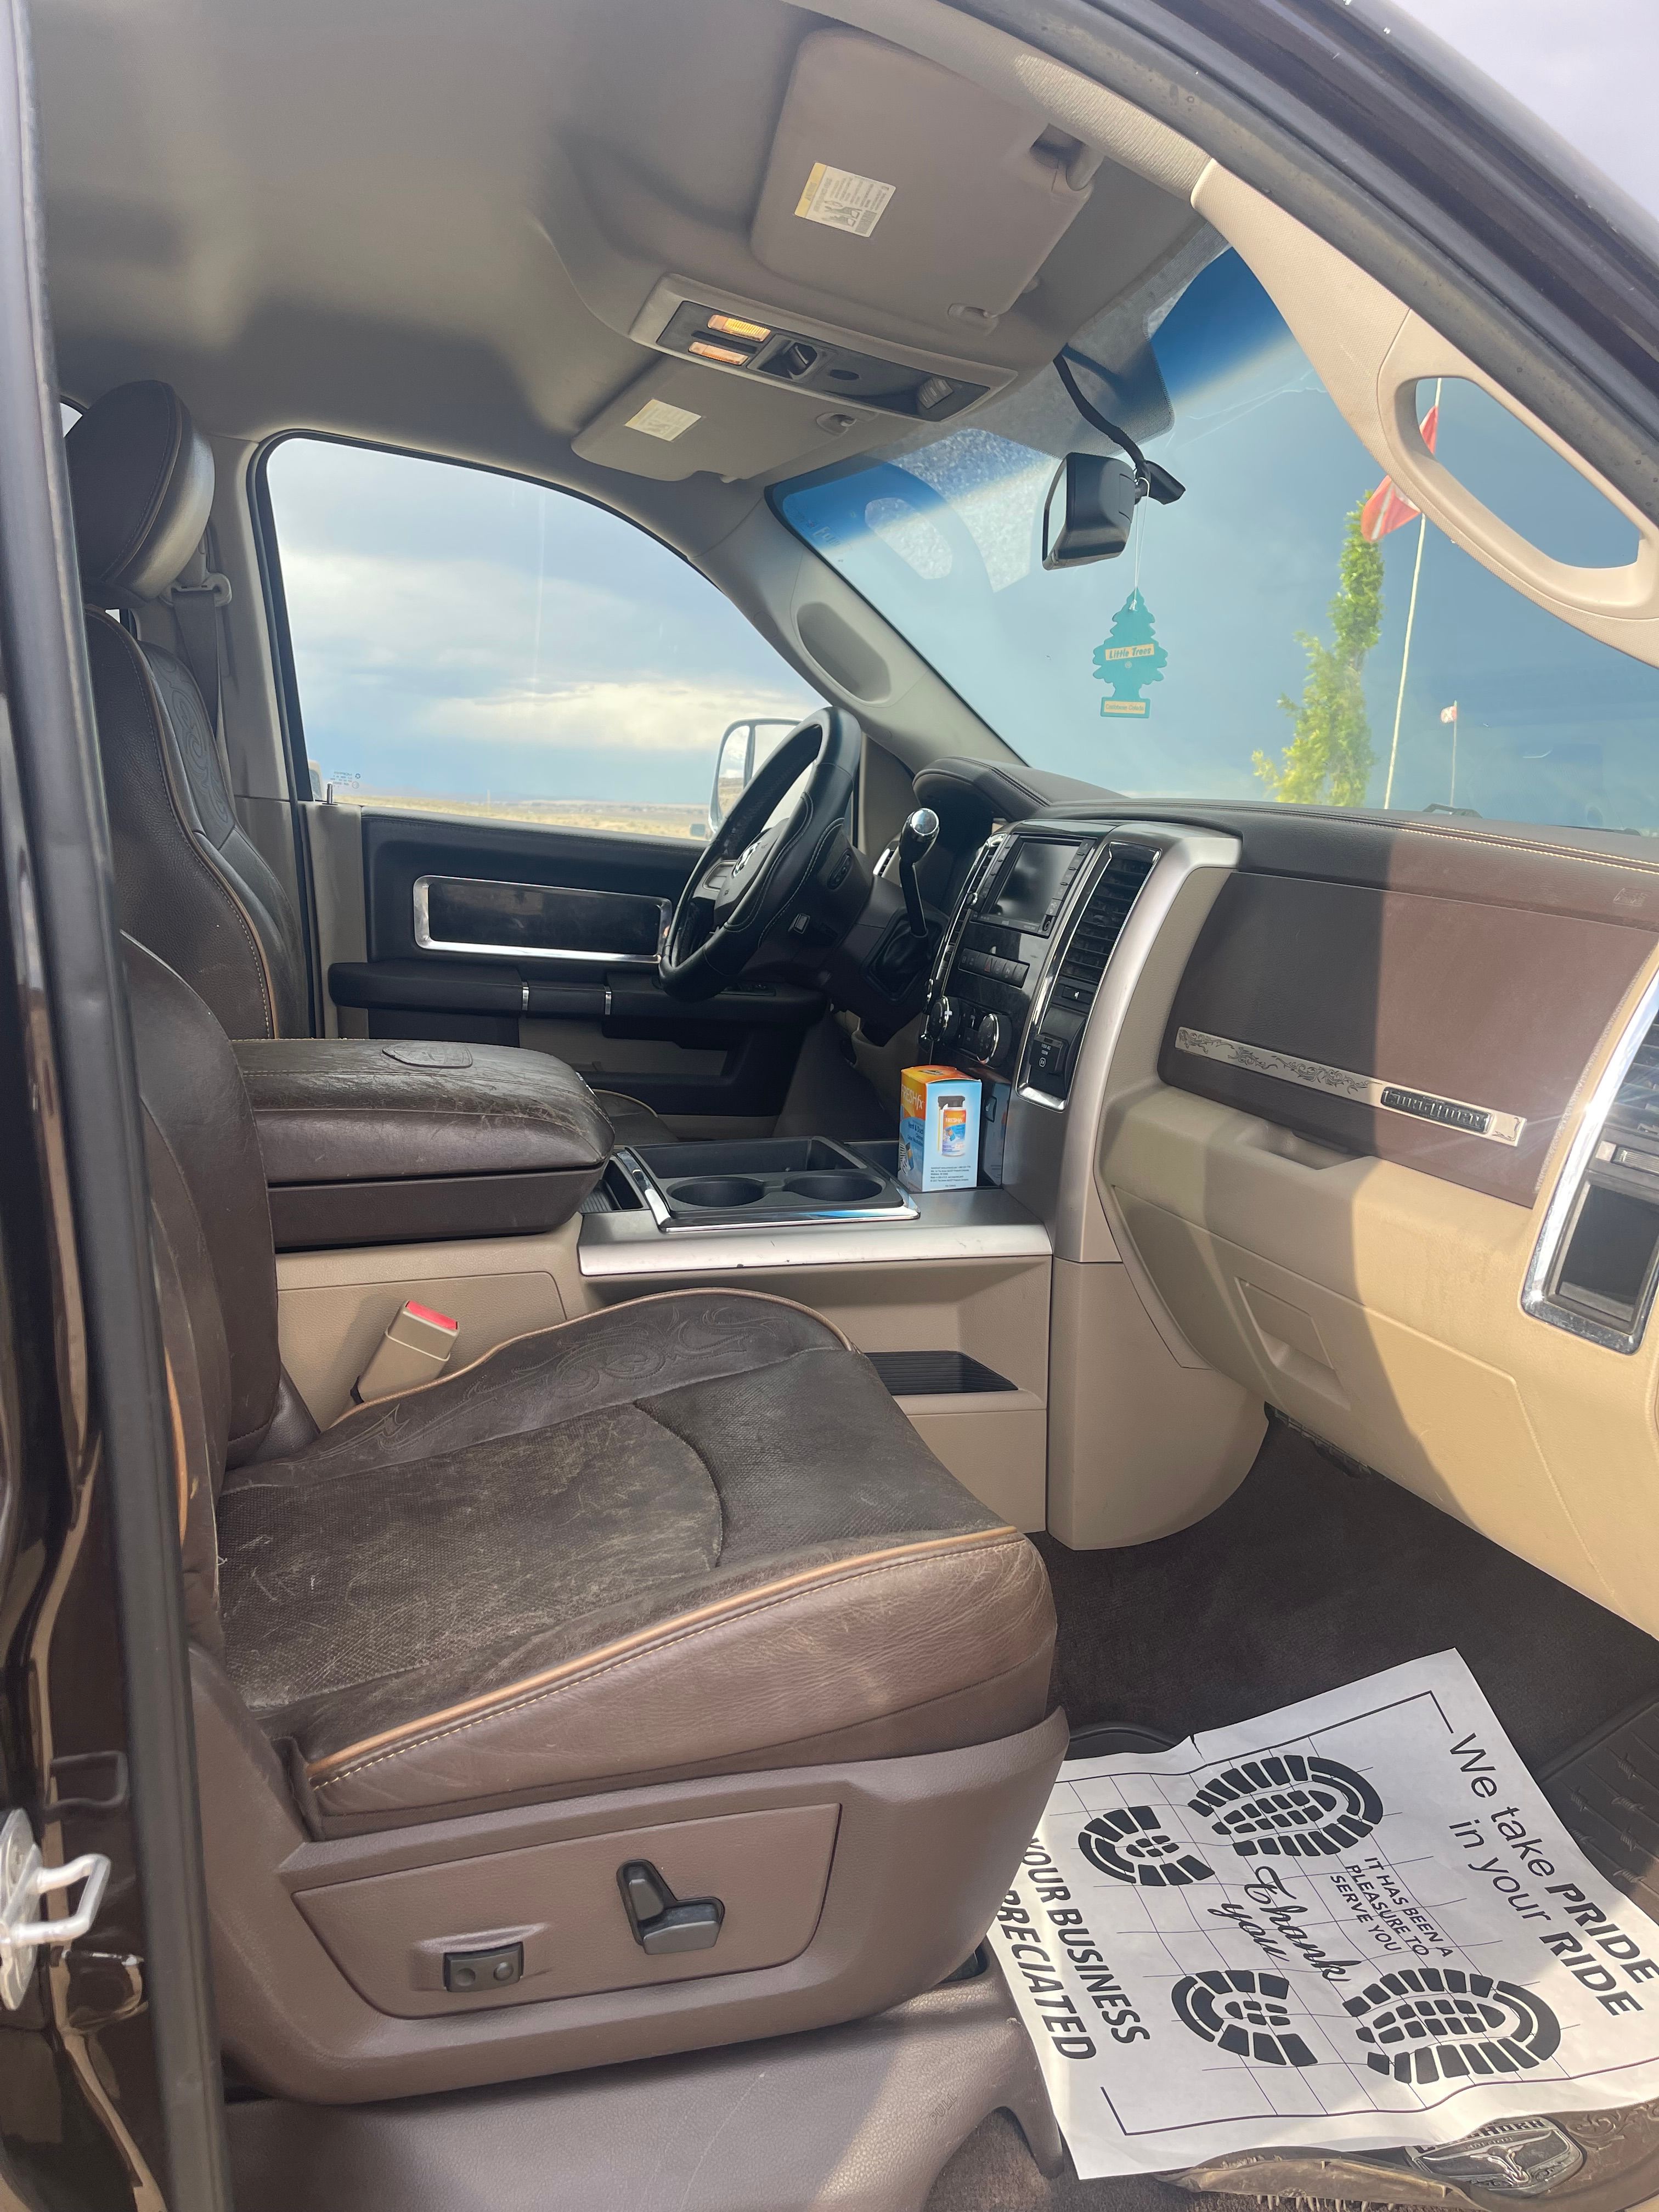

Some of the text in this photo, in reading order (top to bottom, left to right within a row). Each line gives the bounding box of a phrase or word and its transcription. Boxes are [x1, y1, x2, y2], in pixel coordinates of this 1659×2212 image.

[1109, 647, 1152, 659] Little Trees
[1345, 1864, 1430, 1956] PLEASURE TO
[1364, 1857, 1453, 1957] IT HAS BEEN A
[1449, 1733, 1659, 1984] We take PRIDE
[1207, 1903, 1290, 1962] you
[1244, 1866, 1362, 1982] Thank
[1330, 1875, 1402, 1951] SERVE YOU
[1448, 1819, 1645, 2016] in your RIDE
[996, 1890, 1097, 2060] PRECIATED
[1046, 1908, 1150, 2044] BUSINESS
